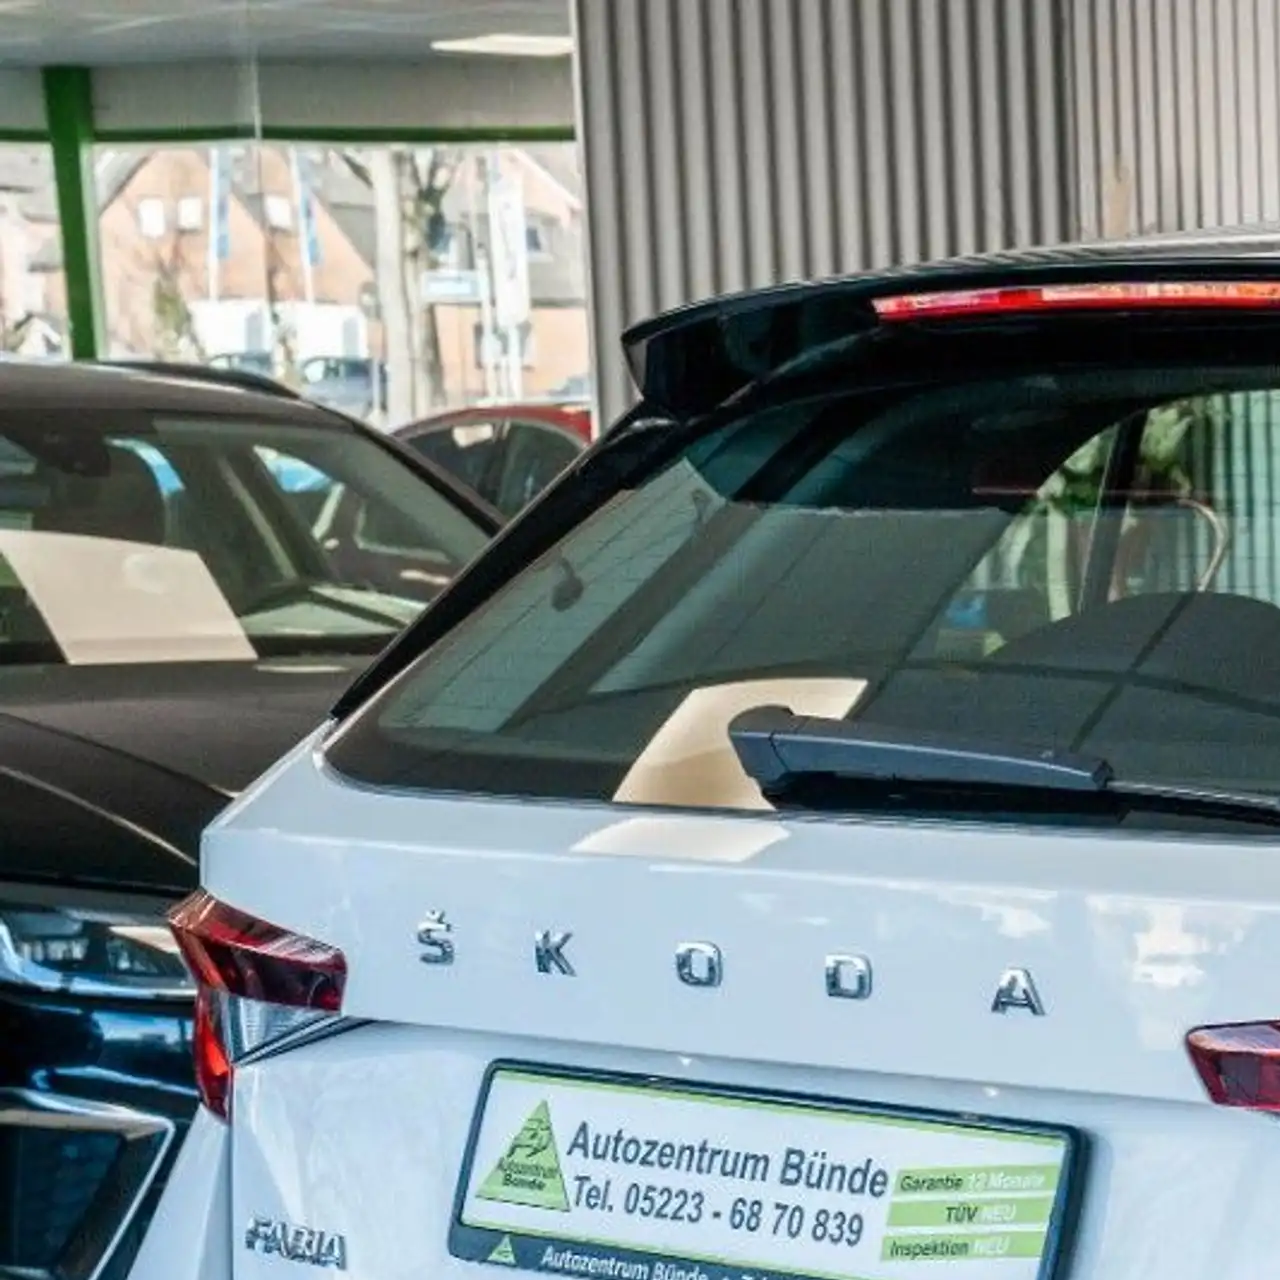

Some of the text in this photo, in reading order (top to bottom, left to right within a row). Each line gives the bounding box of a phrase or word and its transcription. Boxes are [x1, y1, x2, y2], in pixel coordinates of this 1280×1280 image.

[566, 1120, 889, 1198] Autozentrum Bünde
[900, 1172, 964, 1192] Garantie
[574, 1175, 613, 1212] Tel.
[624, 1182, 704, 1223] 05223
[730, 1197, 762, 1232] 68
[773, 1201, 804, 1239] 70
[812, 1208, 864, 1247] 839
[945, 1202, 978, 1223] TÜV
[245, 1217, 347, 1270] FABIA
[890, 1241, 968, 1260] Inspektion
[541, 1246, 649, 1280] Autozentrum
